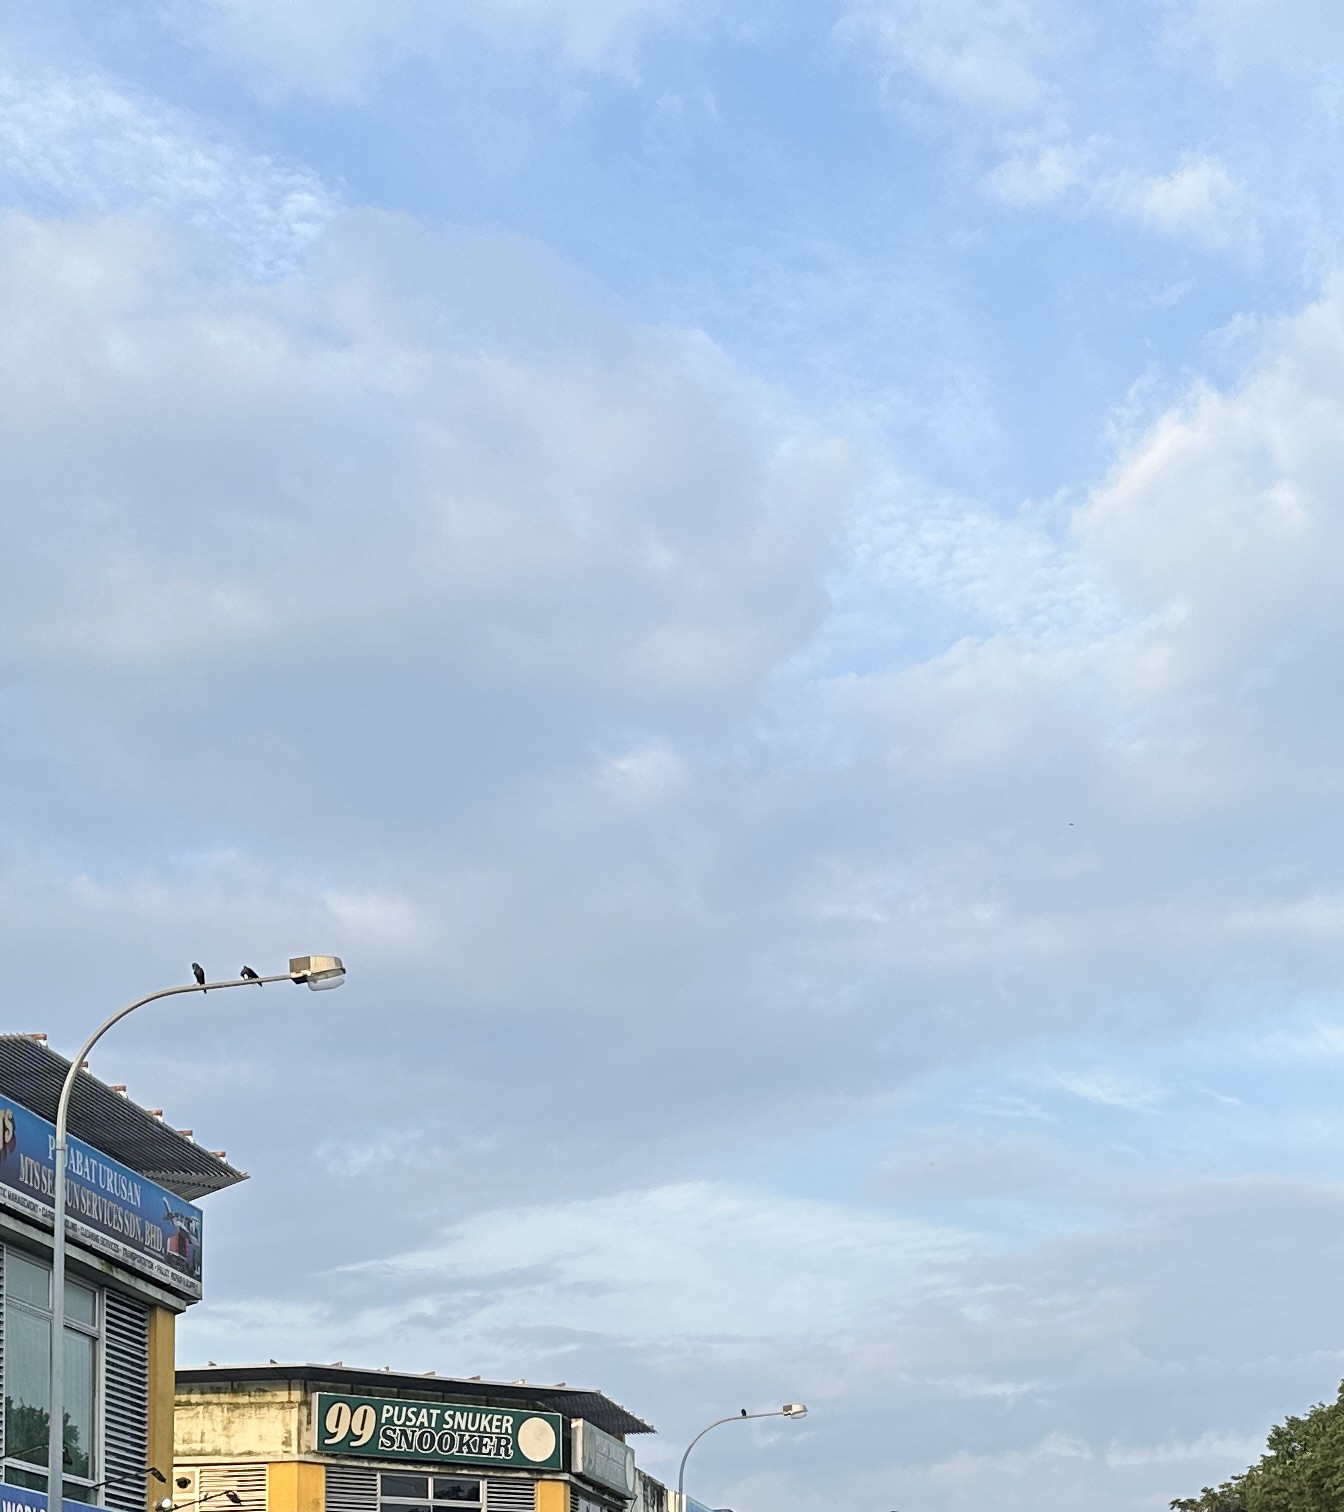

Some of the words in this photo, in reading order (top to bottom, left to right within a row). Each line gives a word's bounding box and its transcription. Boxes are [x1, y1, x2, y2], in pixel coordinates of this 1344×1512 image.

[19, 1153, 41, 1191] MTS
[80, 1186, 124, 1233] SERVICES
[48, 1134, 97, 1184] PJABAT
[99, 1163, 142, 1208] URUSAN
[324, 1402, 376, 1447] 99
[381, 1405, 441, 1427] PUSAT
[444, 1410, 514, 1434] SNUKER
[379, 1426, 514, 1460] SNOOKER
